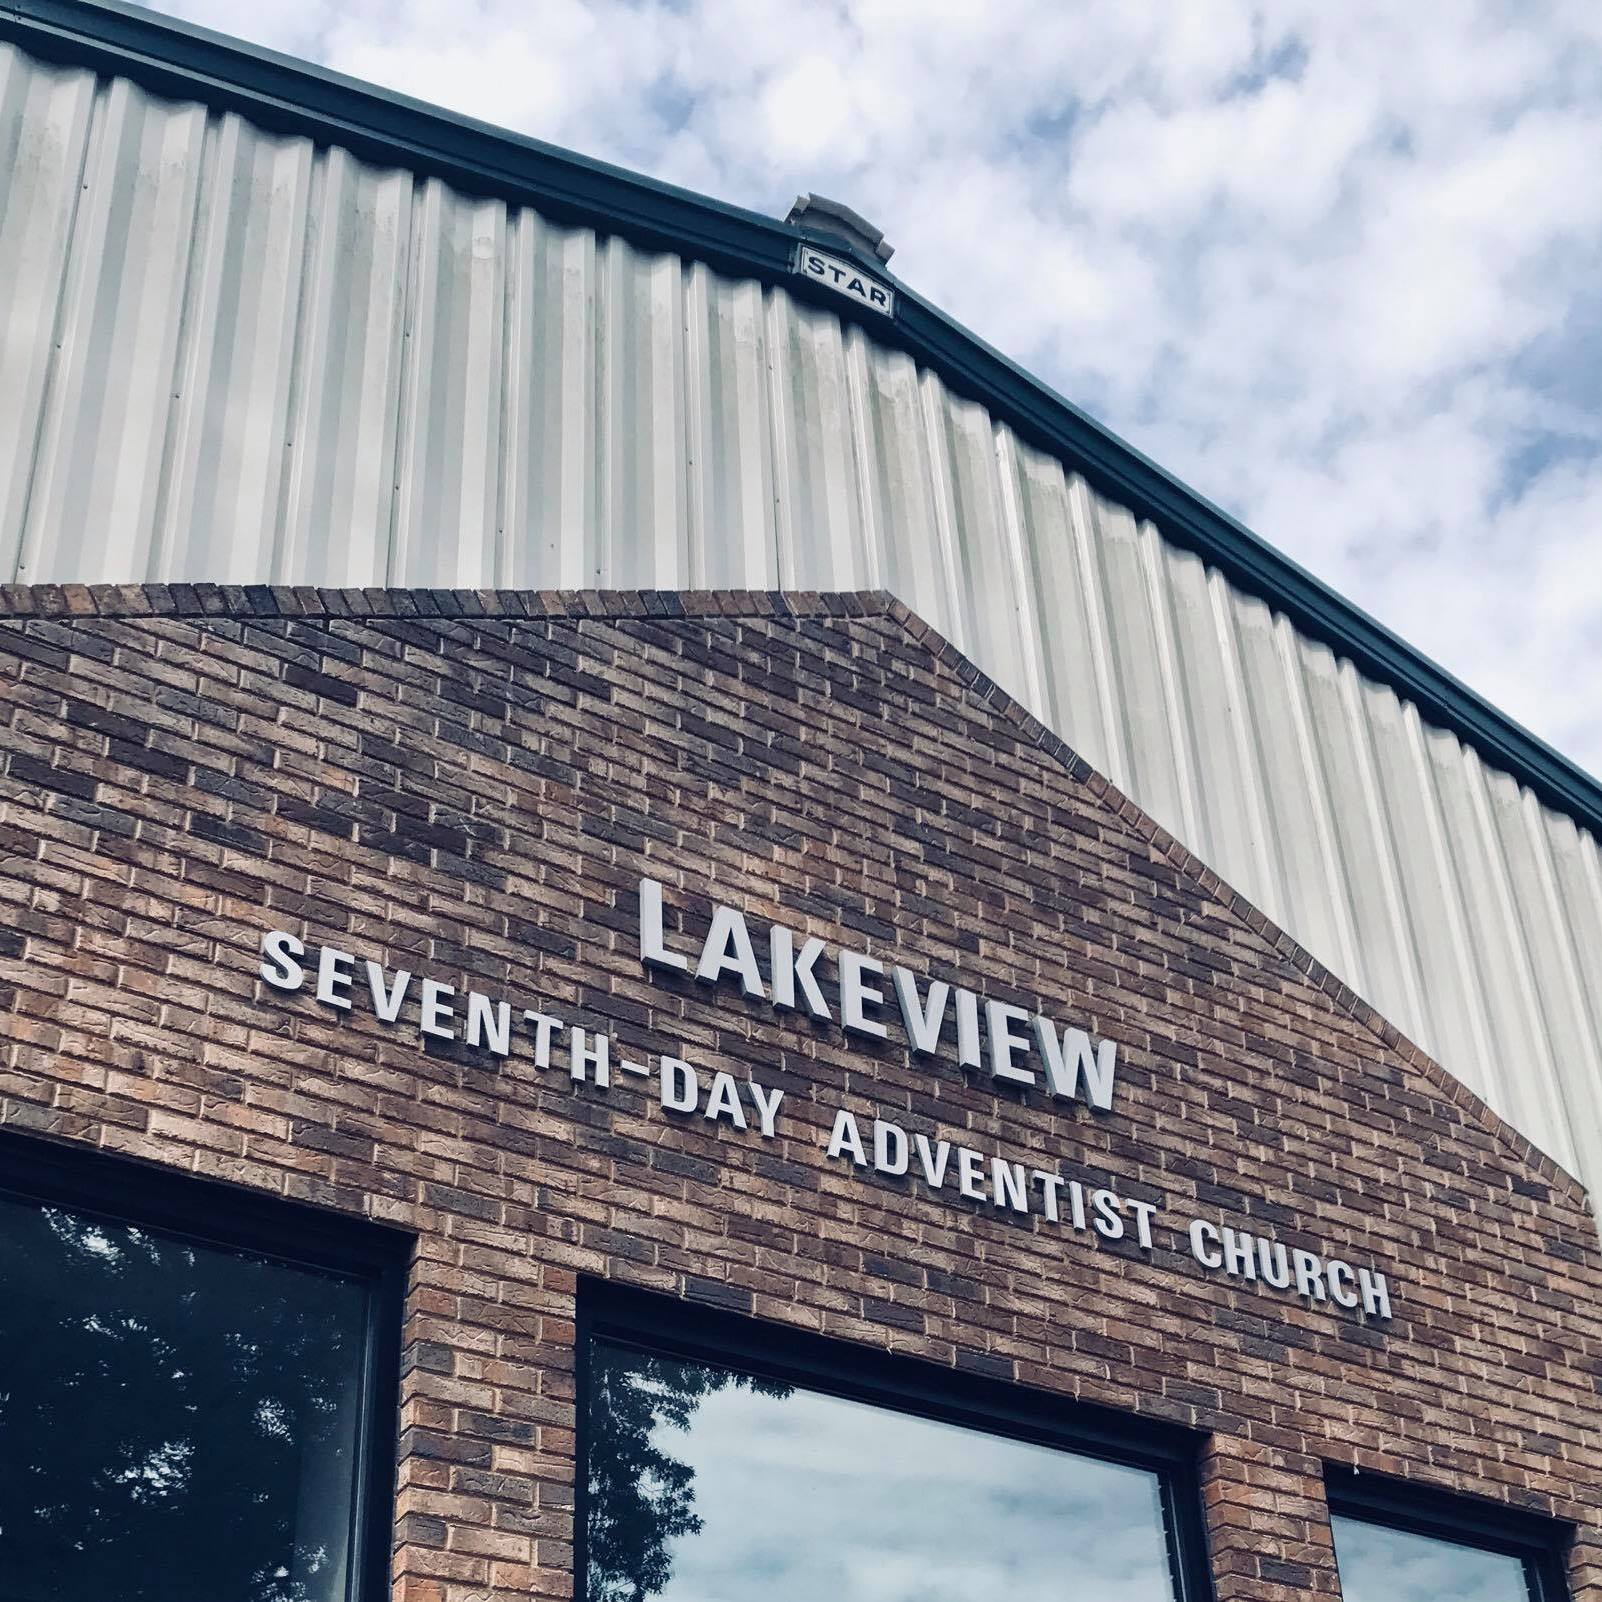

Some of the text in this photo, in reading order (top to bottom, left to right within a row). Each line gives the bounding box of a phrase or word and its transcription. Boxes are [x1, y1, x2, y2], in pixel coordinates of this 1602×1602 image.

[808, 256, 887, 307] STAR
[639, 878, 1118, 1111] LAKEVIEW
[259, 930, 1393, 1319] SEVENTH-DAY ADVENTIST CHURCH
